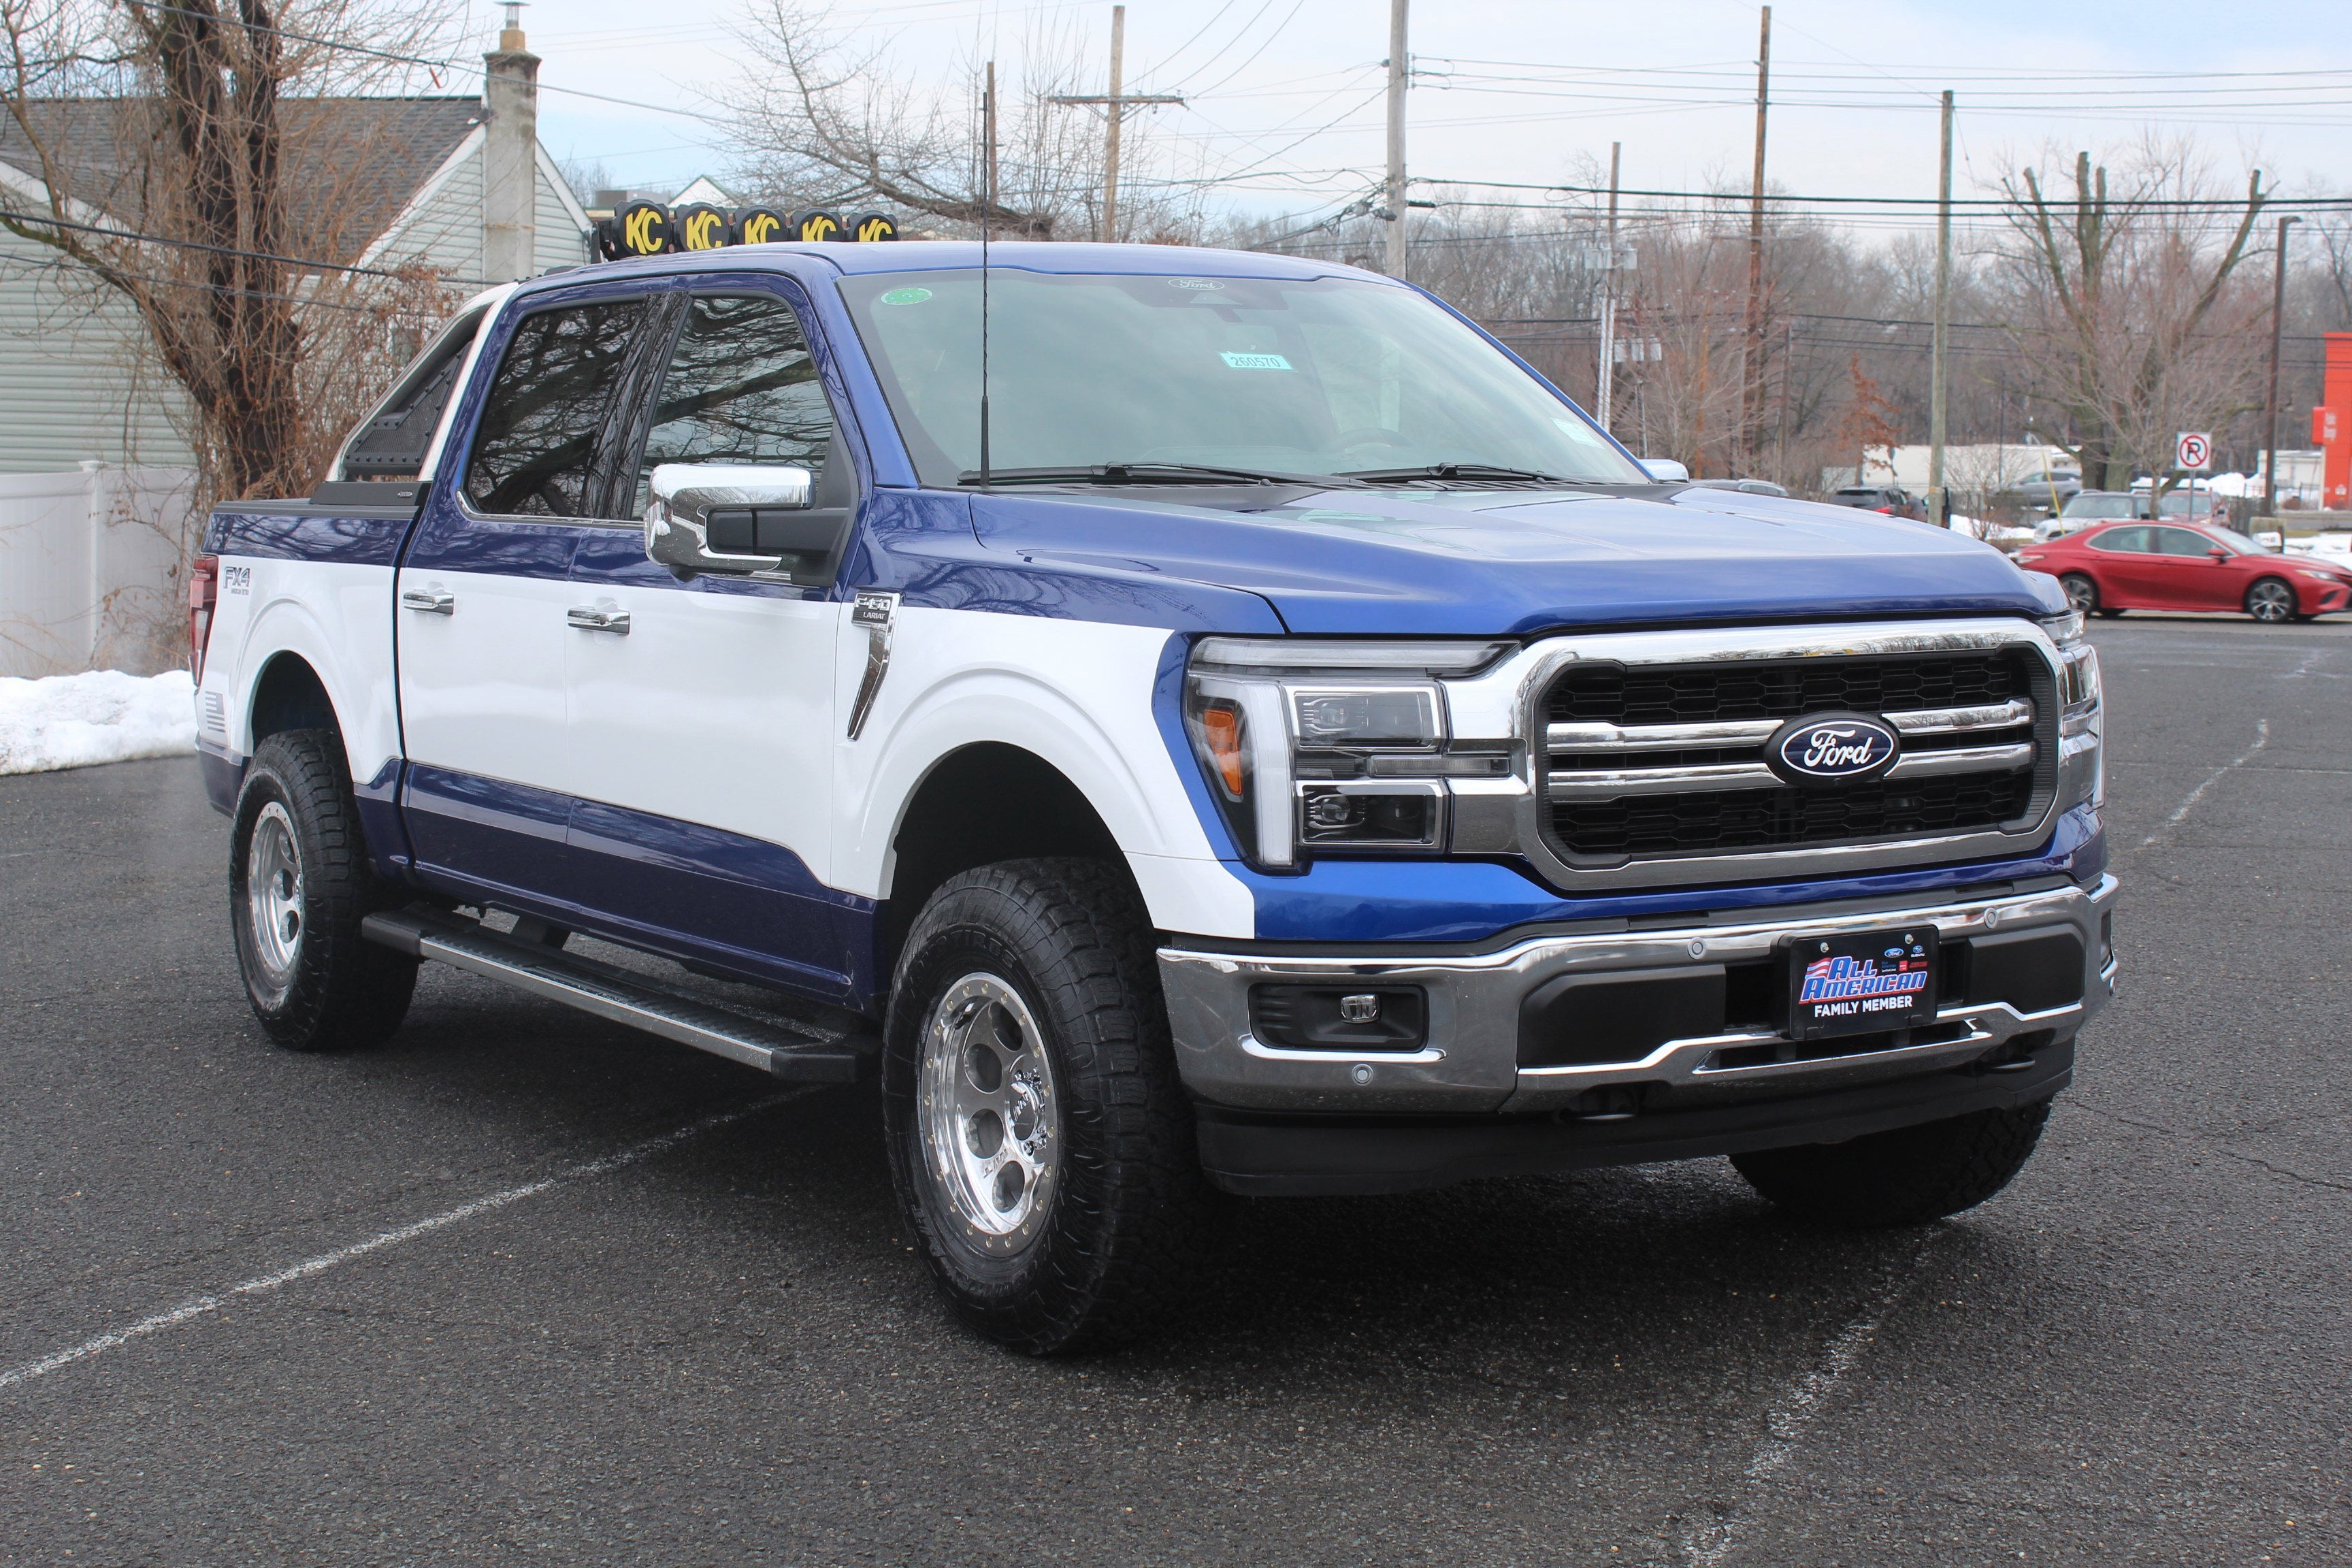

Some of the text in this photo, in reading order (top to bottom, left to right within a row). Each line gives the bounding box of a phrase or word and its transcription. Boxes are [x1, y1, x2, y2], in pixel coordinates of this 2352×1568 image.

[625, 208, 663, 255] KC
[686, 210, 722, 250] KC
[745, 214, 780, 244] KC
[1180, 279, 1215, 289] Ford
[1230, 357, 1281, 368] 260570
[223, 566, 250, 589] FX4
[863, 611, 886, 620] LARIAT
[1803, 730, 1874, 767] Ford
[1814, 996, 1913, 1017] FAMILY MEMBER
